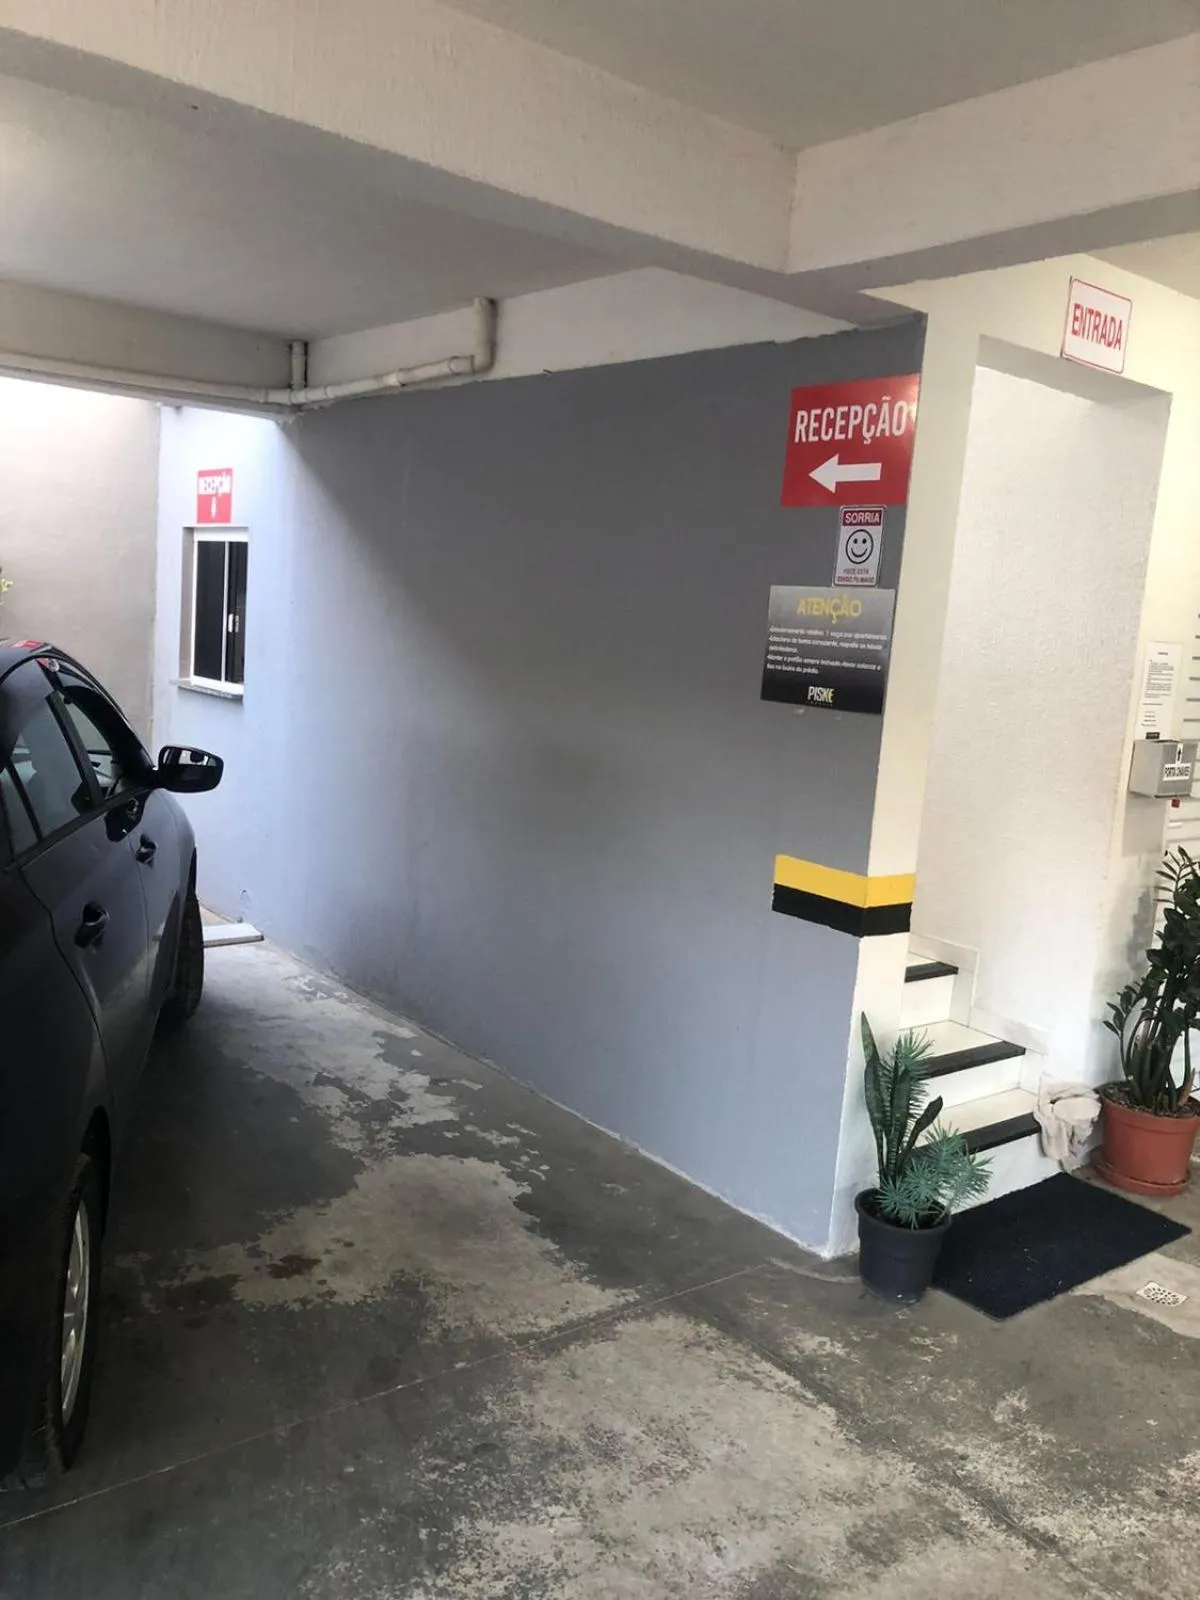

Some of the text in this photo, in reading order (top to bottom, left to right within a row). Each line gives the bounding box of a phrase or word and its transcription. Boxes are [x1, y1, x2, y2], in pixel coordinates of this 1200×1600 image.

[1071, 303, 1124, 352] ENTRADA
[794, 395, 907, 444] RECEPÇÃO
[845, 511, 880, 524] SORRIA
[797, 594, 862, 624] ATENÇÃO
[808, 686, 835, 703] PISKE
